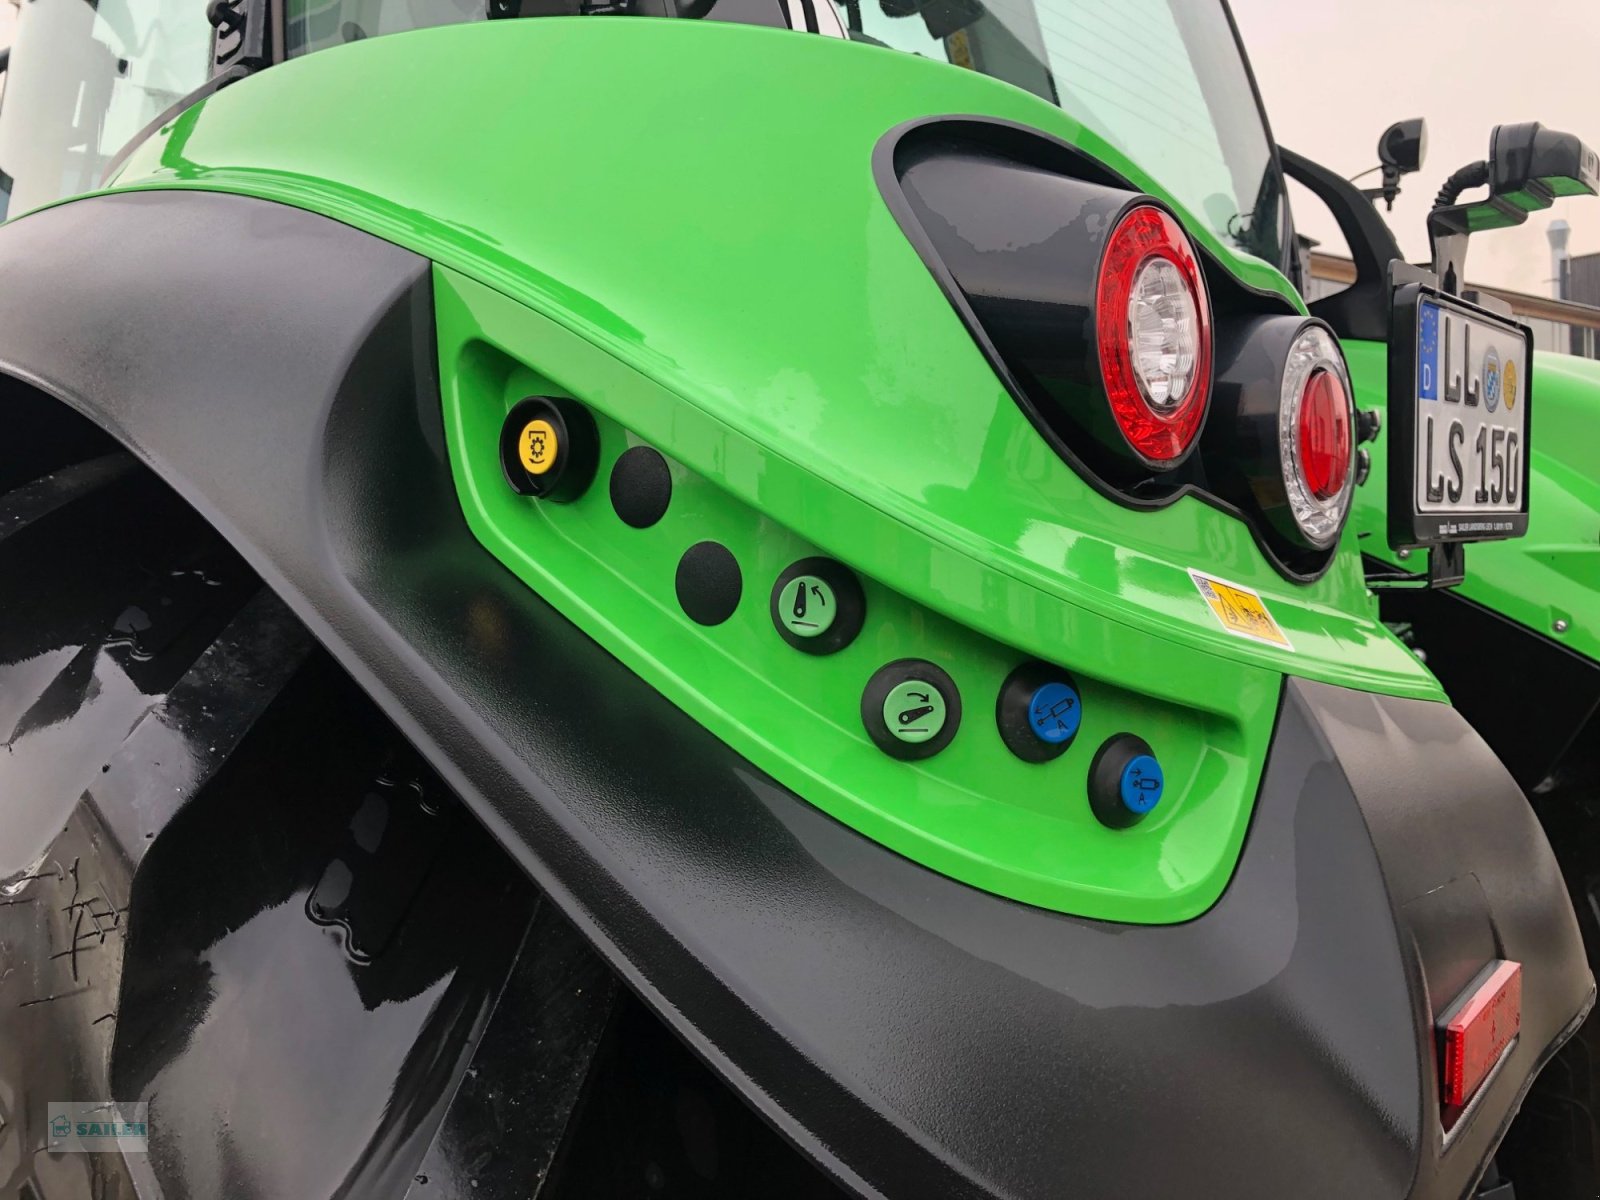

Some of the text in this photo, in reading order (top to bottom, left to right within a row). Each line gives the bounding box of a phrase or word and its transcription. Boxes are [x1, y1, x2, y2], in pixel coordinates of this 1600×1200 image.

[1444, 316, 1479, 407] LL
[1422, 364, 1432, 391] D
[1426, 416, 1518, 504] LS 150
[1057, 719, 1069, 733] A
[1138, 792, 1146, 806] A
